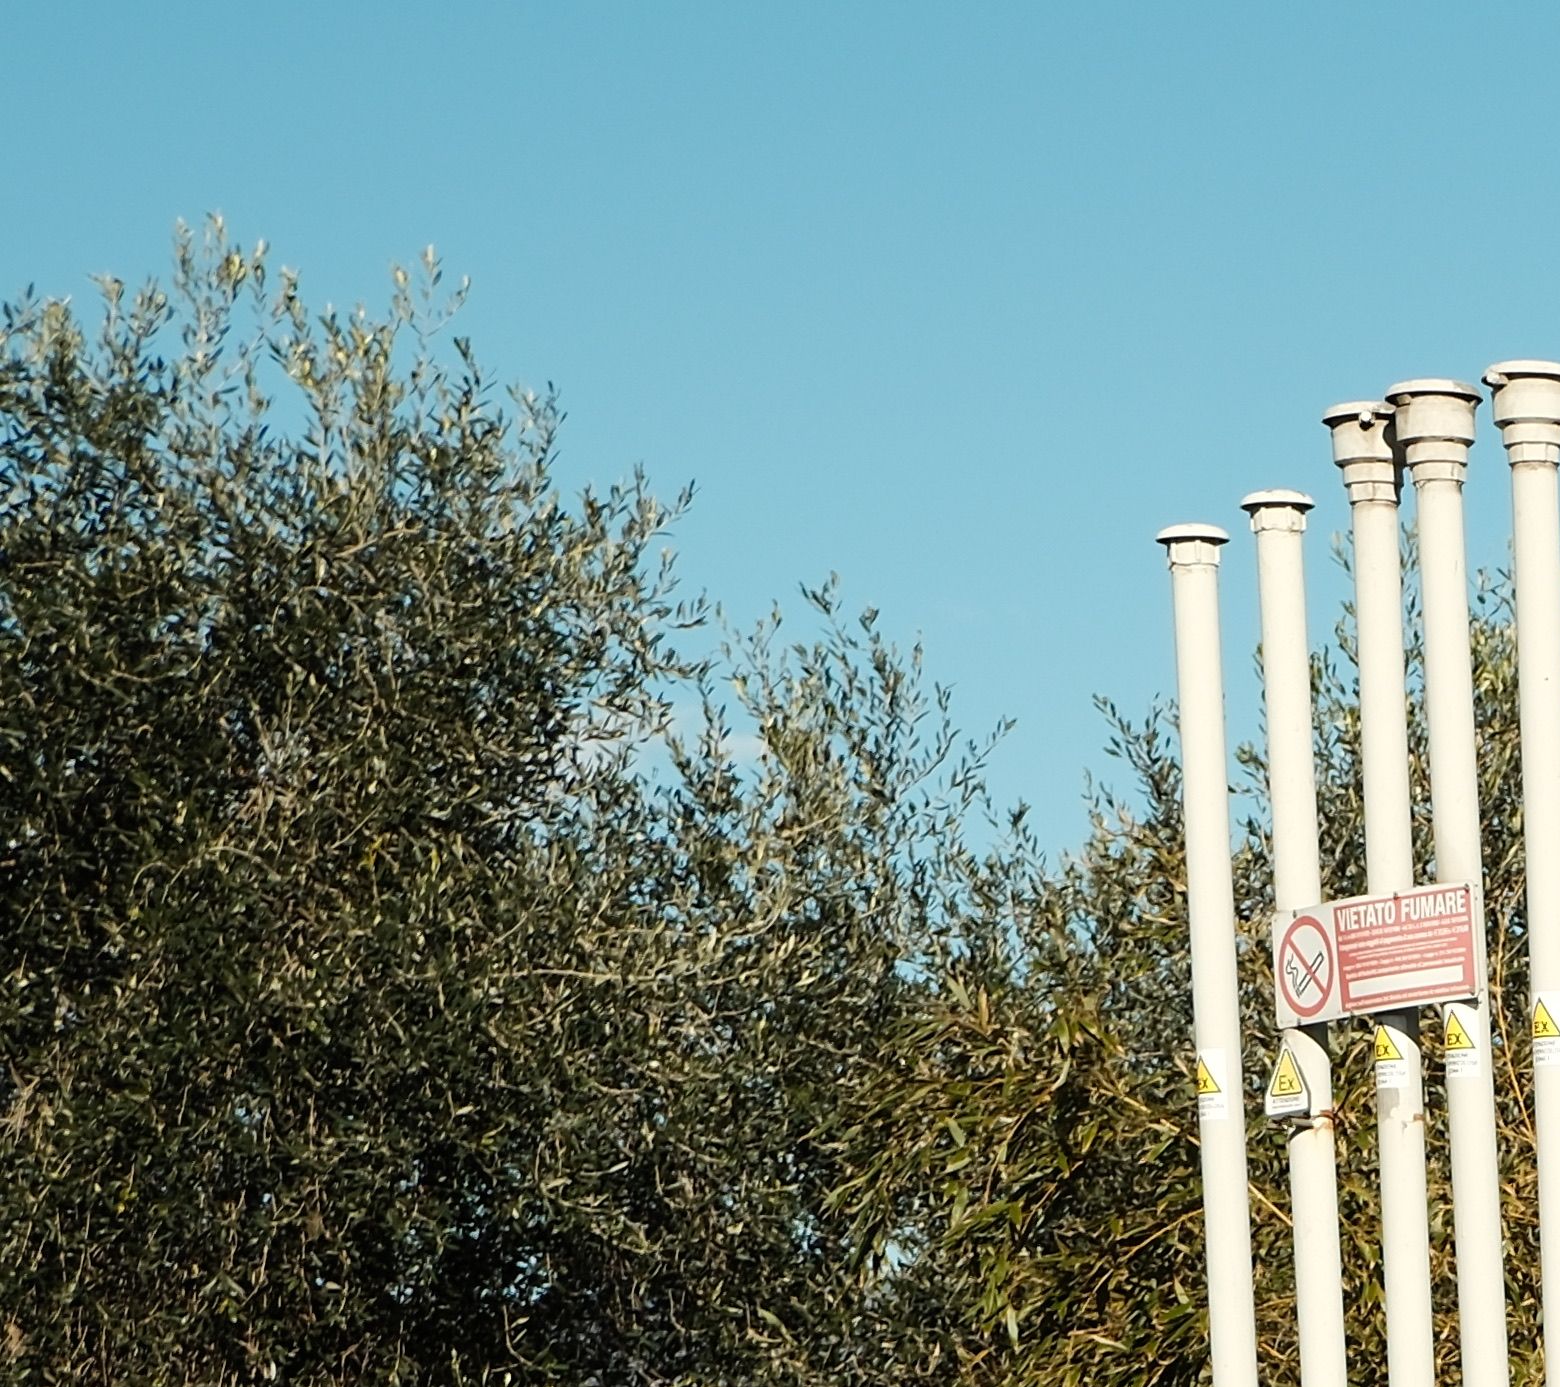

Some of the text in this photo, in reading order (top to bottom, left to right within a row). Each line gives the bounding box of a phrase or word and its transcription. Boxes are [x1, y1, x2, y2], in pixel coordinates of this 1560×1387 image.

[1337, 890, 1467, 931] VIETATO FUMARE
[1534, 1021, 1549, 1034] EX
[1447, 1033, 1462, 1046] EX
[1376, 1044, 1390, 1057] EX
